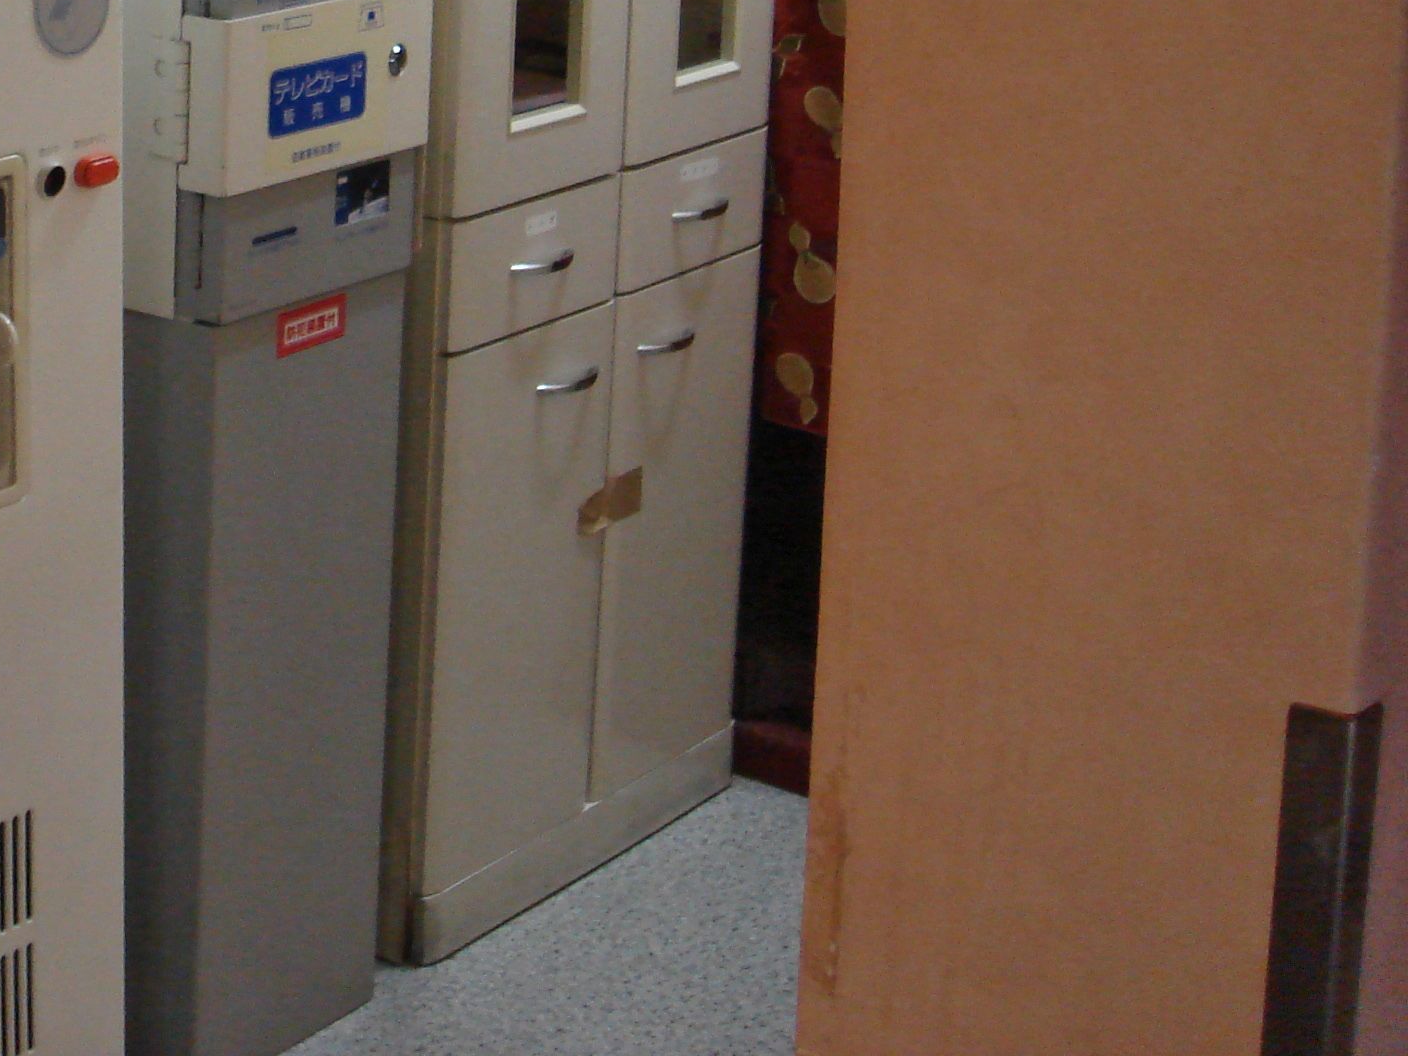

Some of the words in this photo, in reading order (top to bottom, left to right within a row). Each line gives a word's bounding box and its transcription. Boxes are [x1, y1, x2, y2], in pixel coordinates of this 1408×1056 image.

[272, 61, 365, 106] テレビカード
